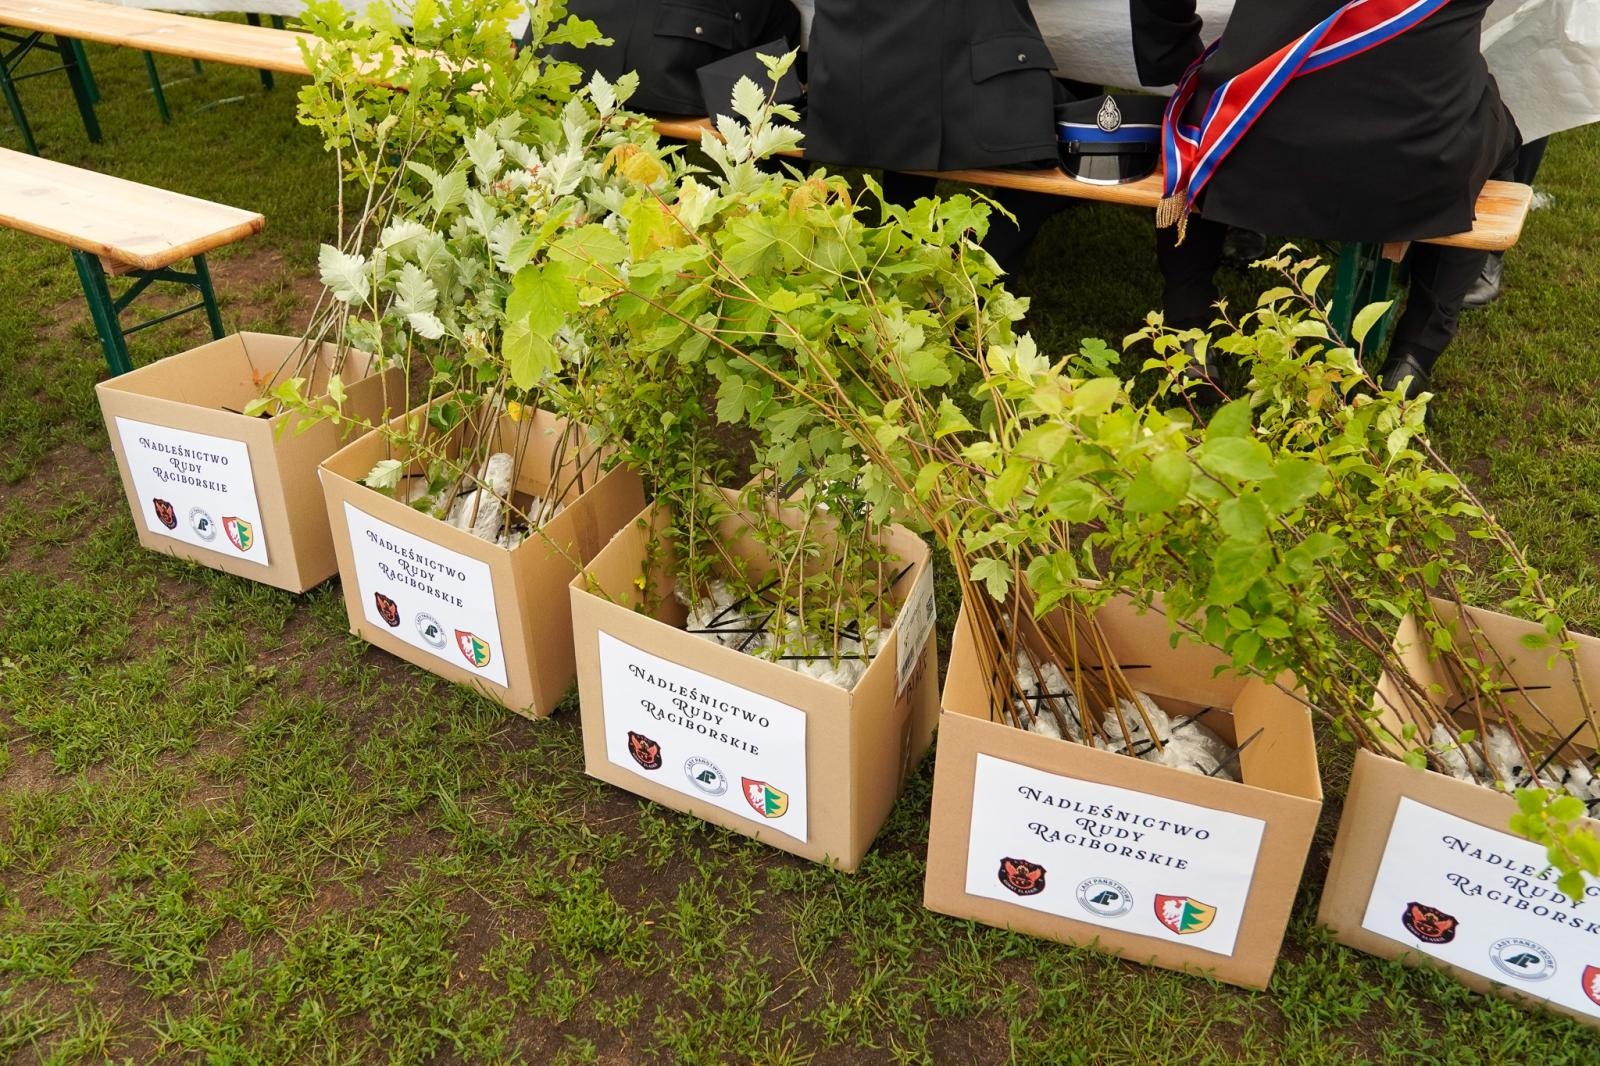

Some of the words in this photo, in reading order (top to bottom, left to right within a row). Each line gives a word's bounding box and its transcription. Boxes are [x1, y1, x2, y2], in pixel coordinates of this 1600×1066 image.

[139, 437, 229, 466] NADLEŚNICTWO
[169, 457, 202, 474] RUDY
[152, 466, 228, 493] RACIBORSKIE
[366, 529, 466, 581] NADLEŚNICTWO
[398, 558, 435, 582] RUDY
[378, 562, 464, 608] RACIBORSKIE
[628, 663, 770, 728] NADLEŚNICTWO
[672, 697, 724, 726] RUDY
[640, 699, 760, 756] RACIBORSKIE
[1018, 785, 1211, 841] NADLEŚNICTWO
[1075, 816, 1146, 843] RUDY
[1028, 821, 1189, 871] RACIBORSKIE
